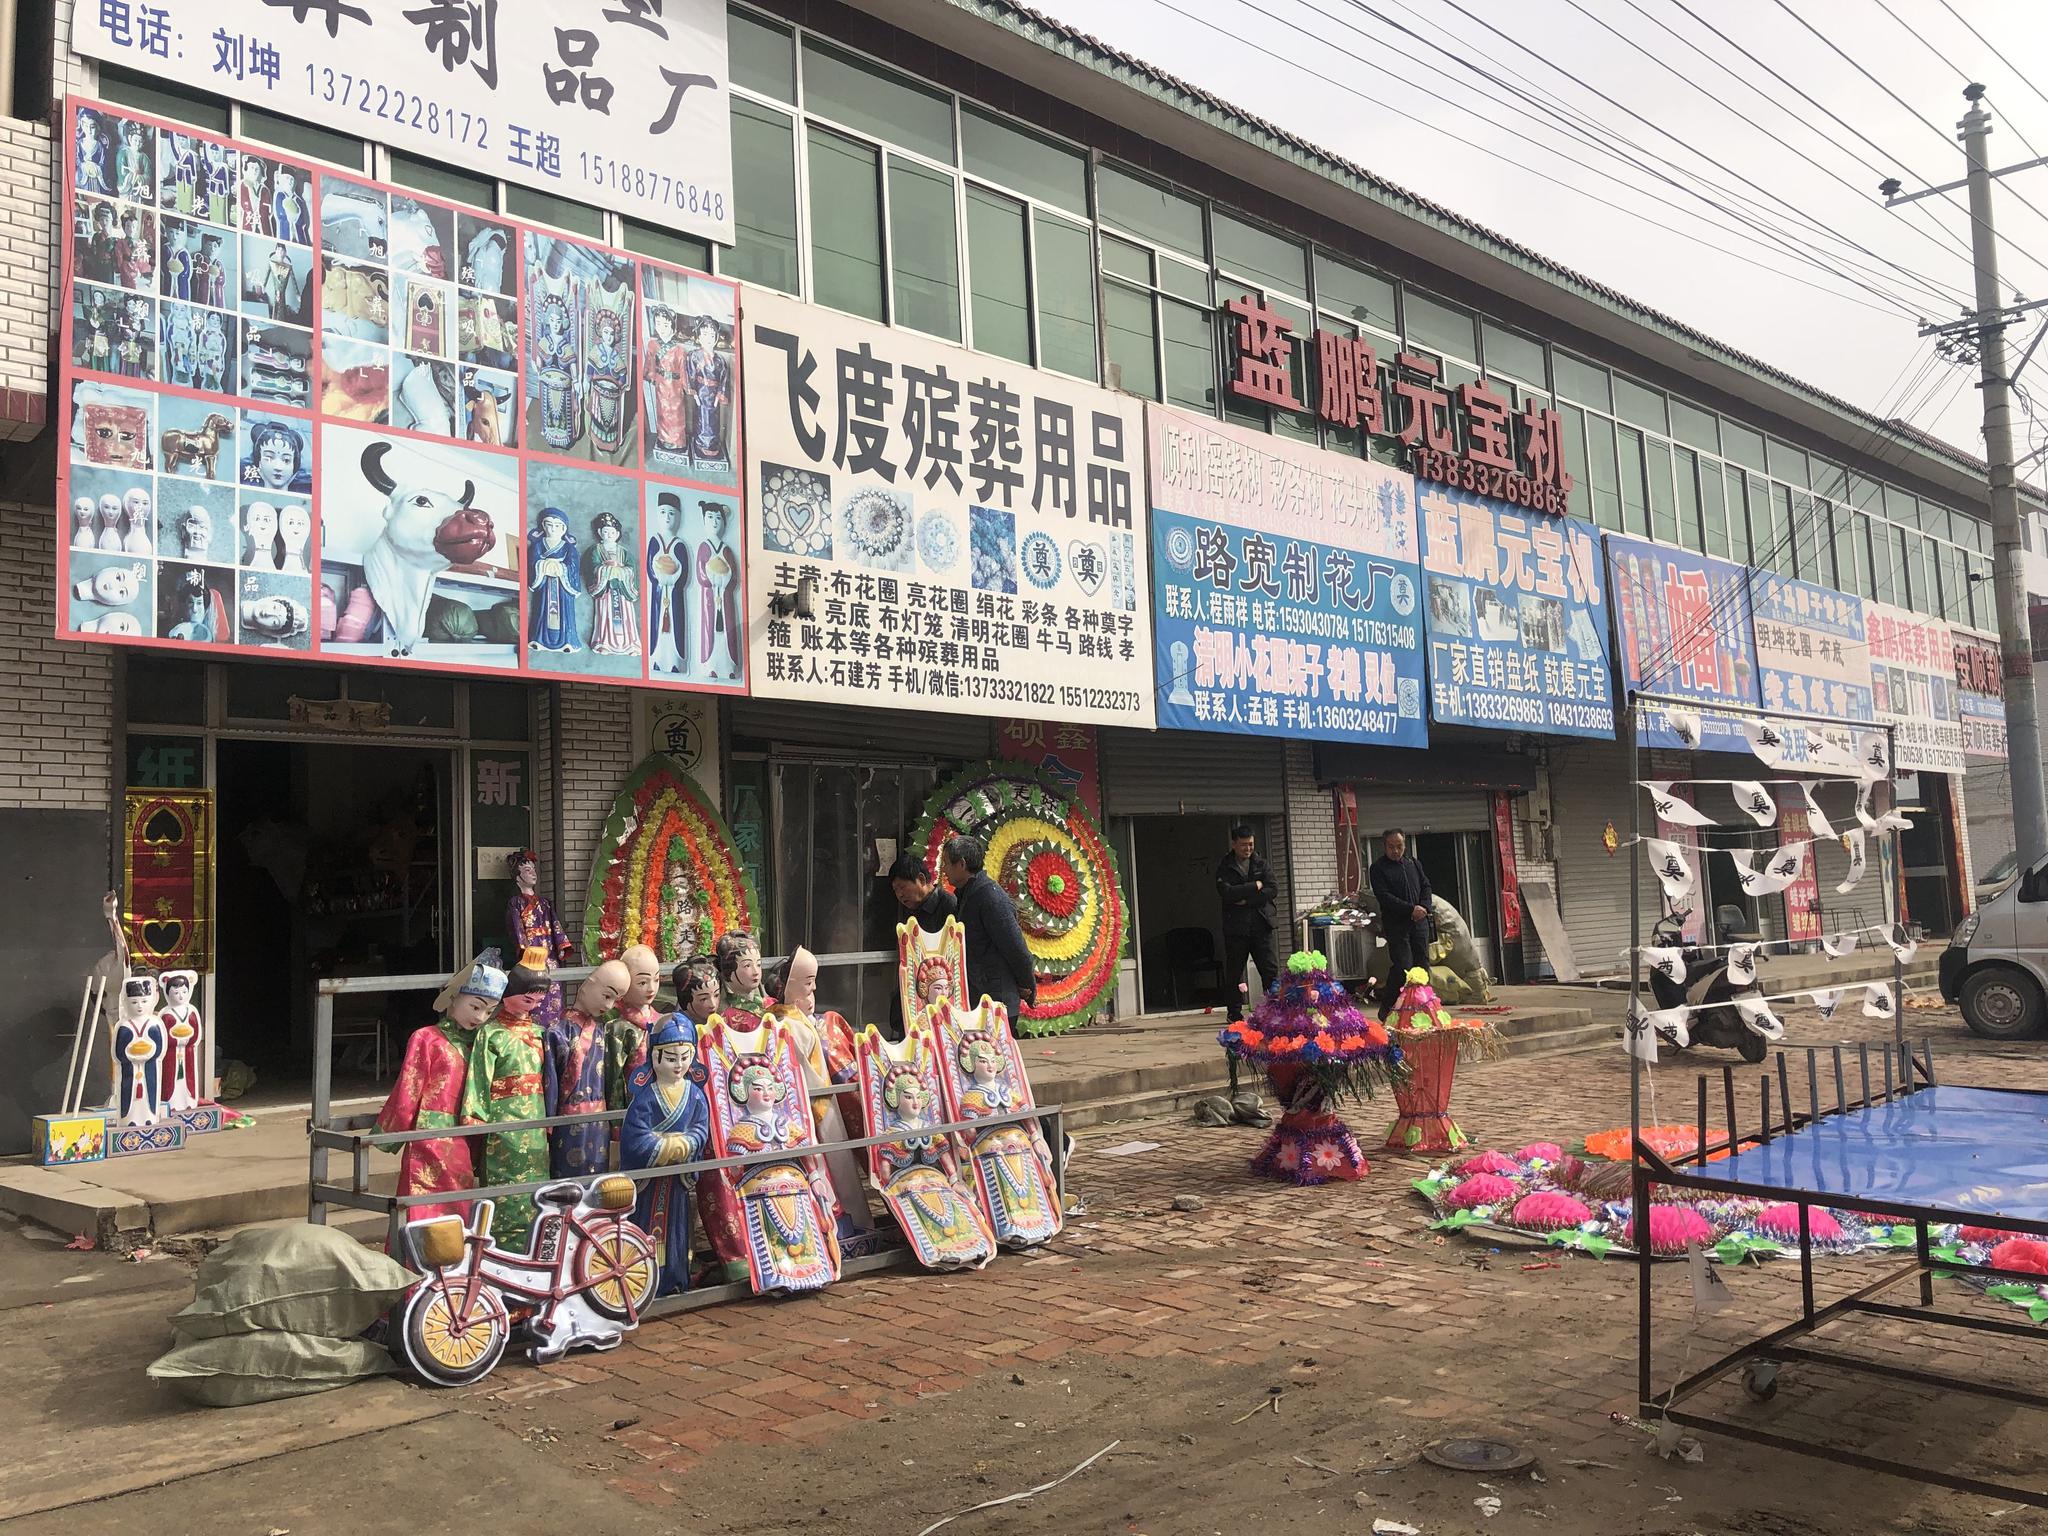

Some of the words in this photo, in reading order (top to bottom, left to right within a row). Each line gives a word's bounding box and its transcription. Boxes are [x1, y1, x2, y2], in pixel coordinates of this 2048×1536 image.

[98, 0, 184, 59] 电话:
[212, 27, 281, 91] 刘坤
[305, 63, 488, 150] 13722228172
[507, 123, 562, 179] 王超
[580, 151, 724, 221] 15188776848
[1224, 294, 1573, 493] 蓝鹏元宝机
[754, 324, 1132, 530] 飞度殡葬用品
[1417, 447, 1570, 518] 13833269863
[1033, 541, 1051, 578] 奠
[1078, 548, 1099, 585] 奠
[1194, 526, 1395, 611] 路宽制花厂
[1421, 490, 1600, 606] 蓝鹏元宝机
[186, 570, 206, 590] 制
[243, 577, 259, 592] 品
[825, 598, 871, 629] 亮底
[879, 606, 944, 639] 布灯笼
[950, 615, 1030, 650] 清明花圈
[1036, 628, 1072, 655] 牛马
[1079, 634, 1113, 660] 路钱
[1118, 638, 1135, 661] 孝
[907, 582, 969, 615] 亮花圈
[976, 592, 1015, 621] 绢花
[1021, 600, 1058, 627] 彩条
[1065, 605, 1133, 636] 各种奠字
[1351, 618, 1415, 649] 15176315408
[801, 624, 1000, 672] 账本等各种殡葬用品
[1193, 625, 1323, 697] 清明小花圈架子
[1364, 652, 1397, 706] 灵位
[1757, 623, 1812, 658] 明坤花圈
[1867, 610, 1956, 674] 鑫鹏殡葬用品
[766, 652, 882, 690] 联系人:石建芳
[1059, 685, 1140, 712] 15512232373
[1432, 641, 1540, 693] 厂家直销盘纸
[655, 719, 695, 766] 奠
[1548, 702, 1613, 731] 18431238693
[477, 759, 521, 806] 新
[1748, 790, 1770, 815] 奠
[1660, 852, 1684, 881] 奠
